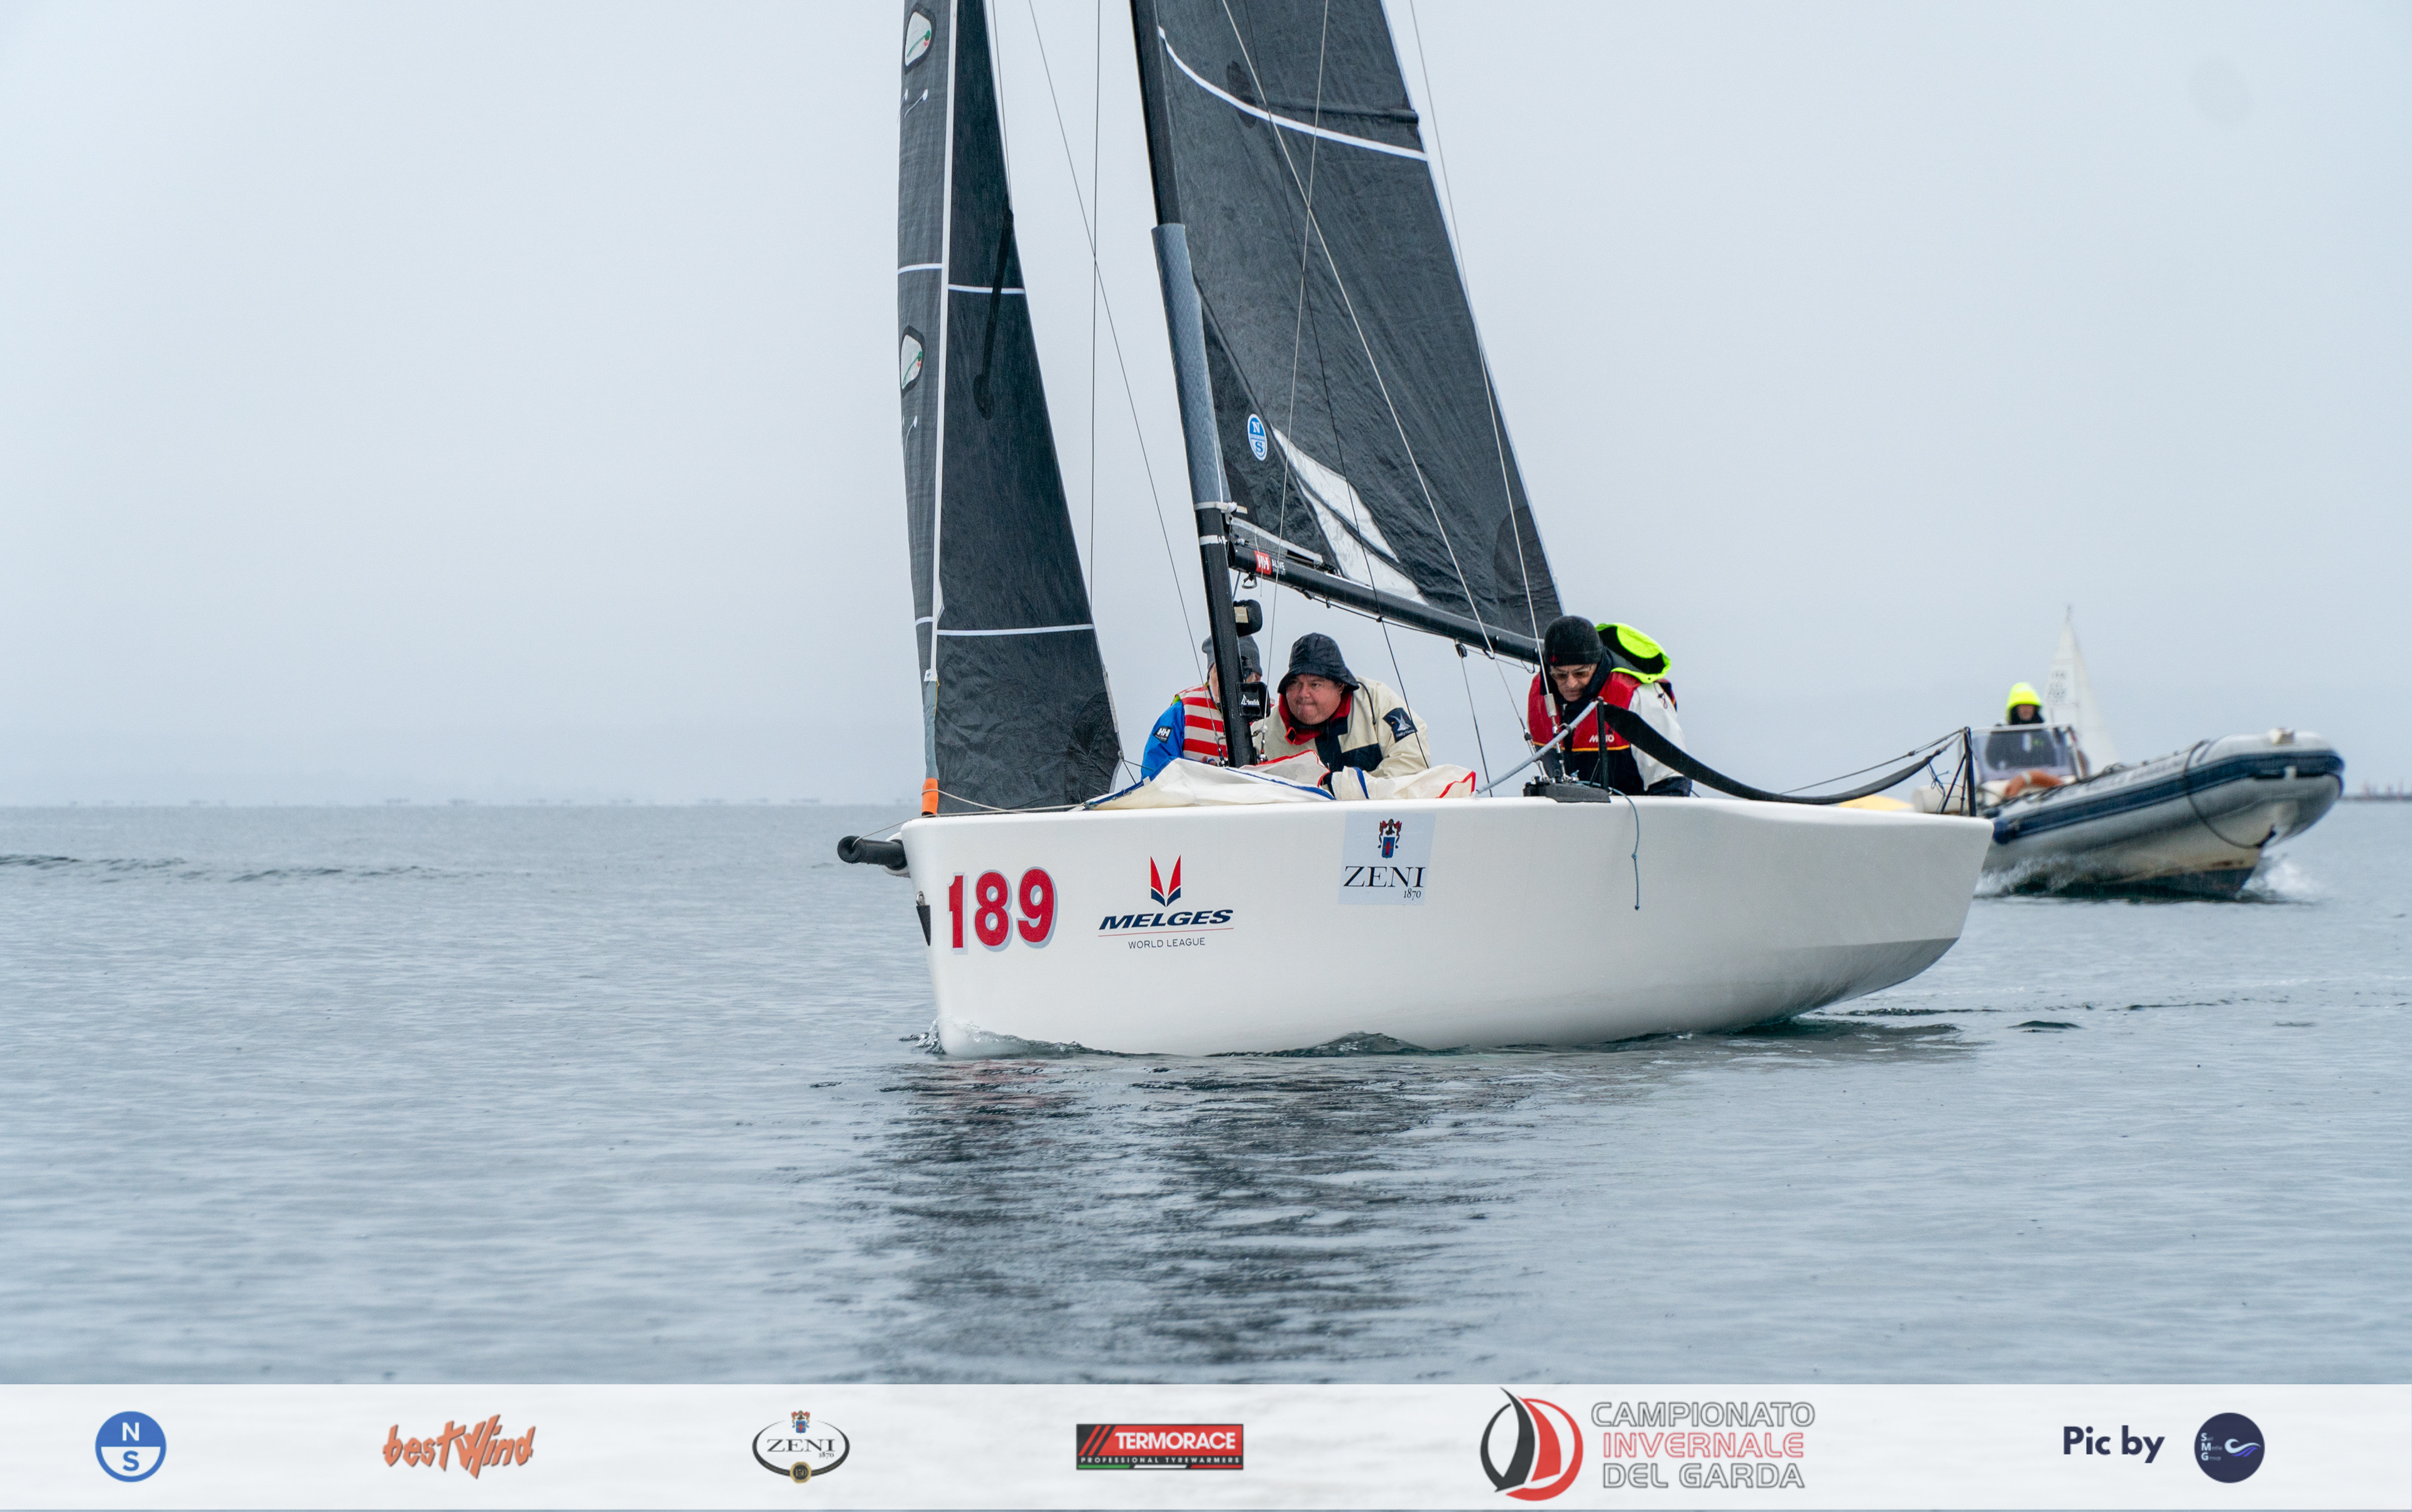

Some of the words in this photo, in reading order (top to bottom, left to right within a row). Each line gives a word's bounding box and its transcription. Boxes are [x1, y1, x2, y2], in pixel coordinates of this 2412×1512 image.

[1251, 421, 1260, 433] N
[1255, 441, 1263, 452] S
[1156, 727, 1171, 737] HH
[1343, 866, 1426, 888] ZENI
[1403, 888, 1421, 901] 1870
[948, 867, 1057, 953] 189
[1098, 908, 1234, 930] MELGES
[1127, 939, 1164, 949] WORLD
[1166, 937, 1206, 947] LEAGUE
